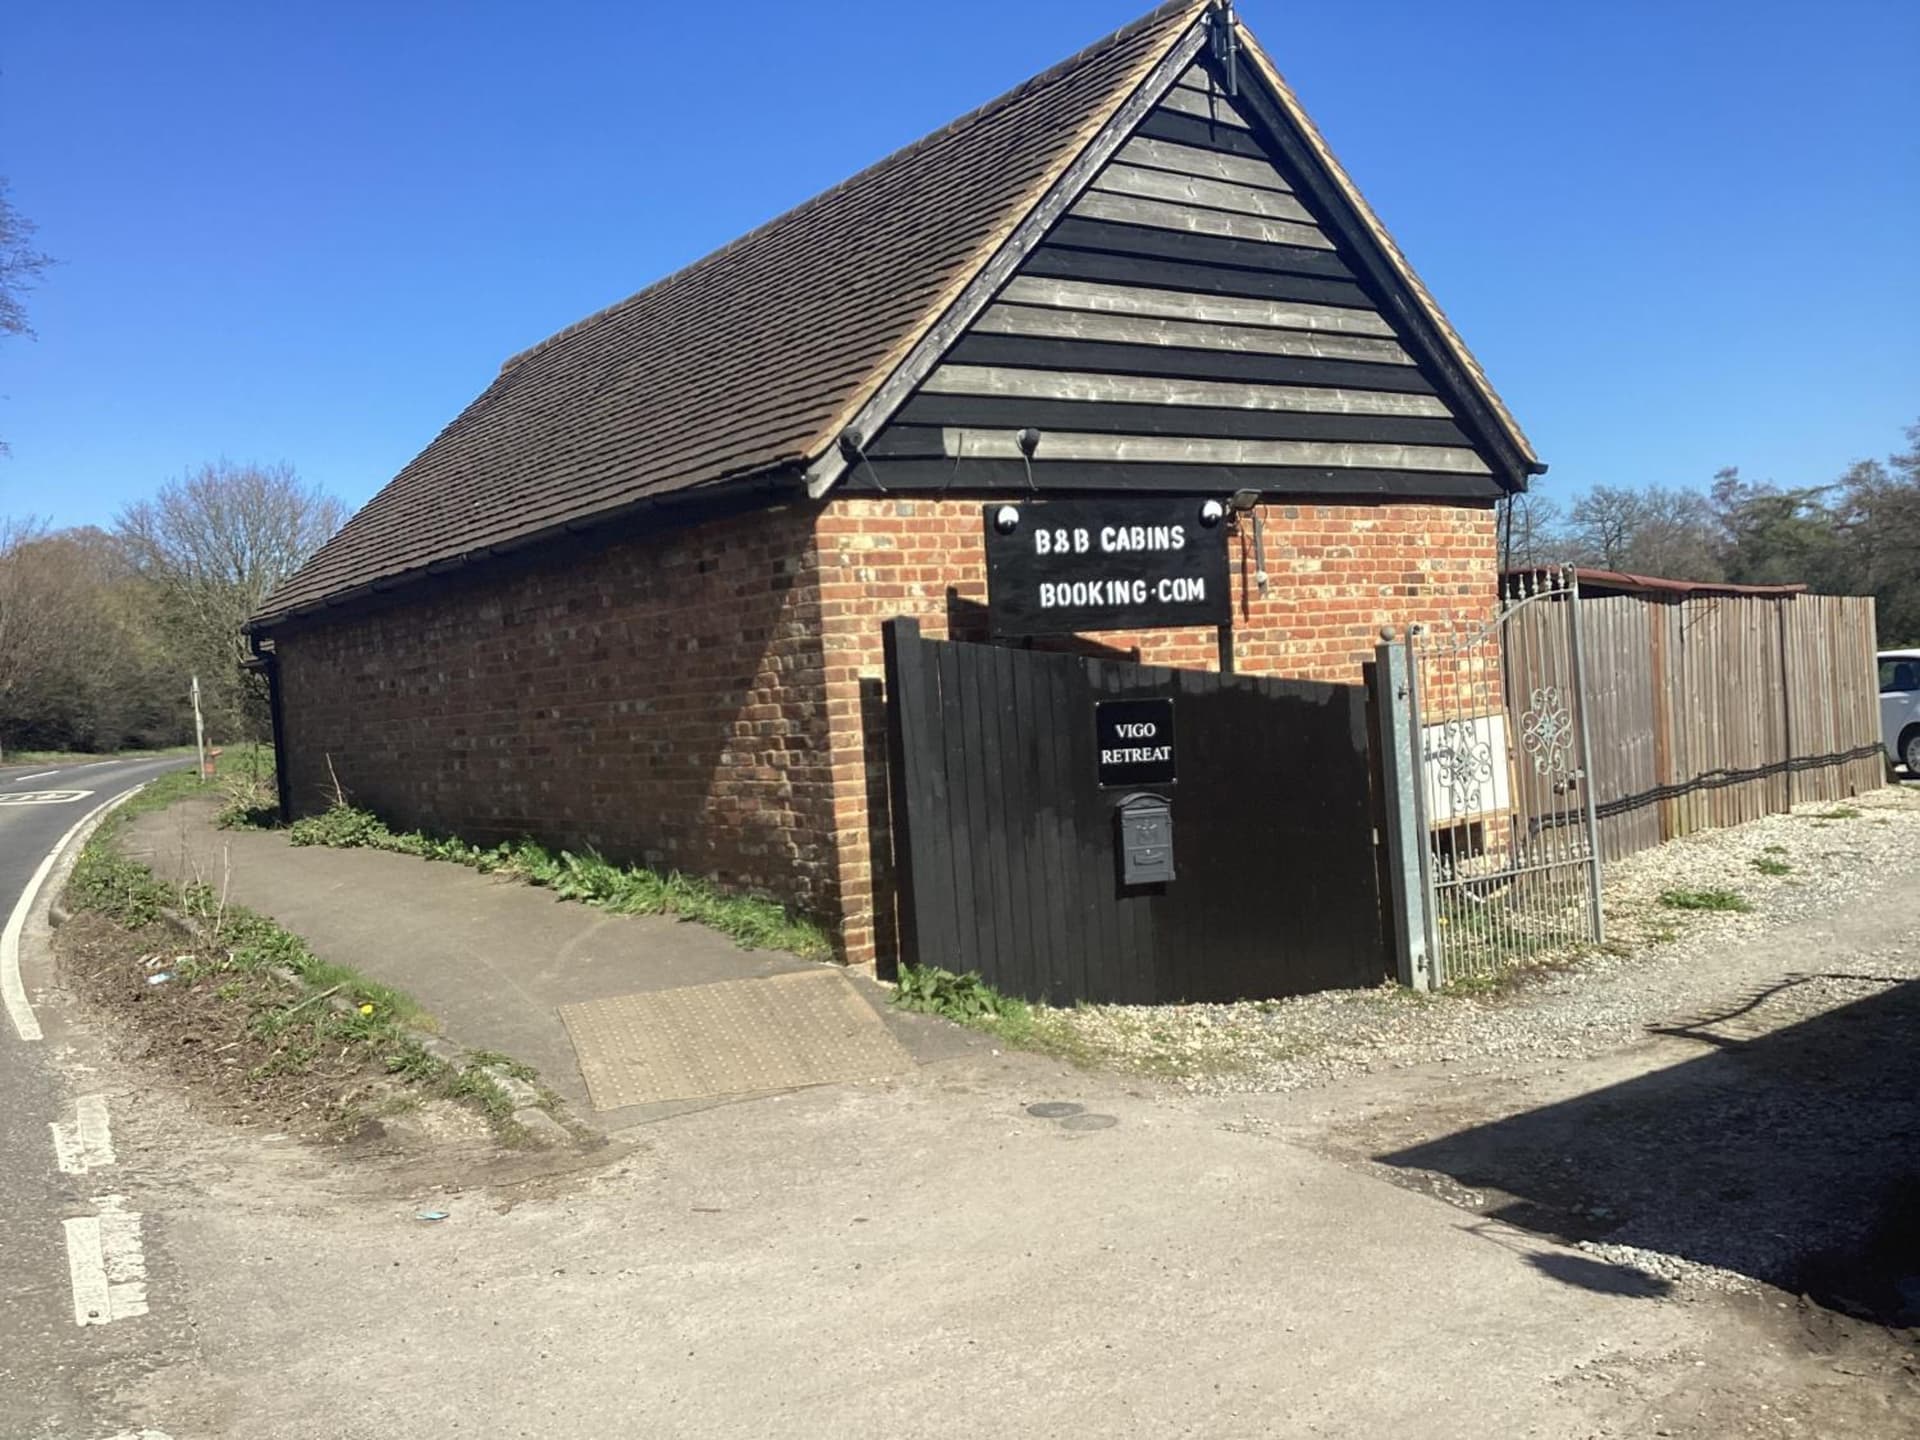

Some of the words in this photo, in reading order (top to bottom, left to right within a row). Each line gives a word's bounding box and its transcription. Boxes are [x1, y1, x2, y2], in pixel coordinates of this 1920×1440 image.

[1035, 528, 1090, 554] B&B
[1101, 525, 1186, 552] CABINS
[1115, 722, 1157, 739] VIGO
[1101, 746, 1172, 764] RETREAT
